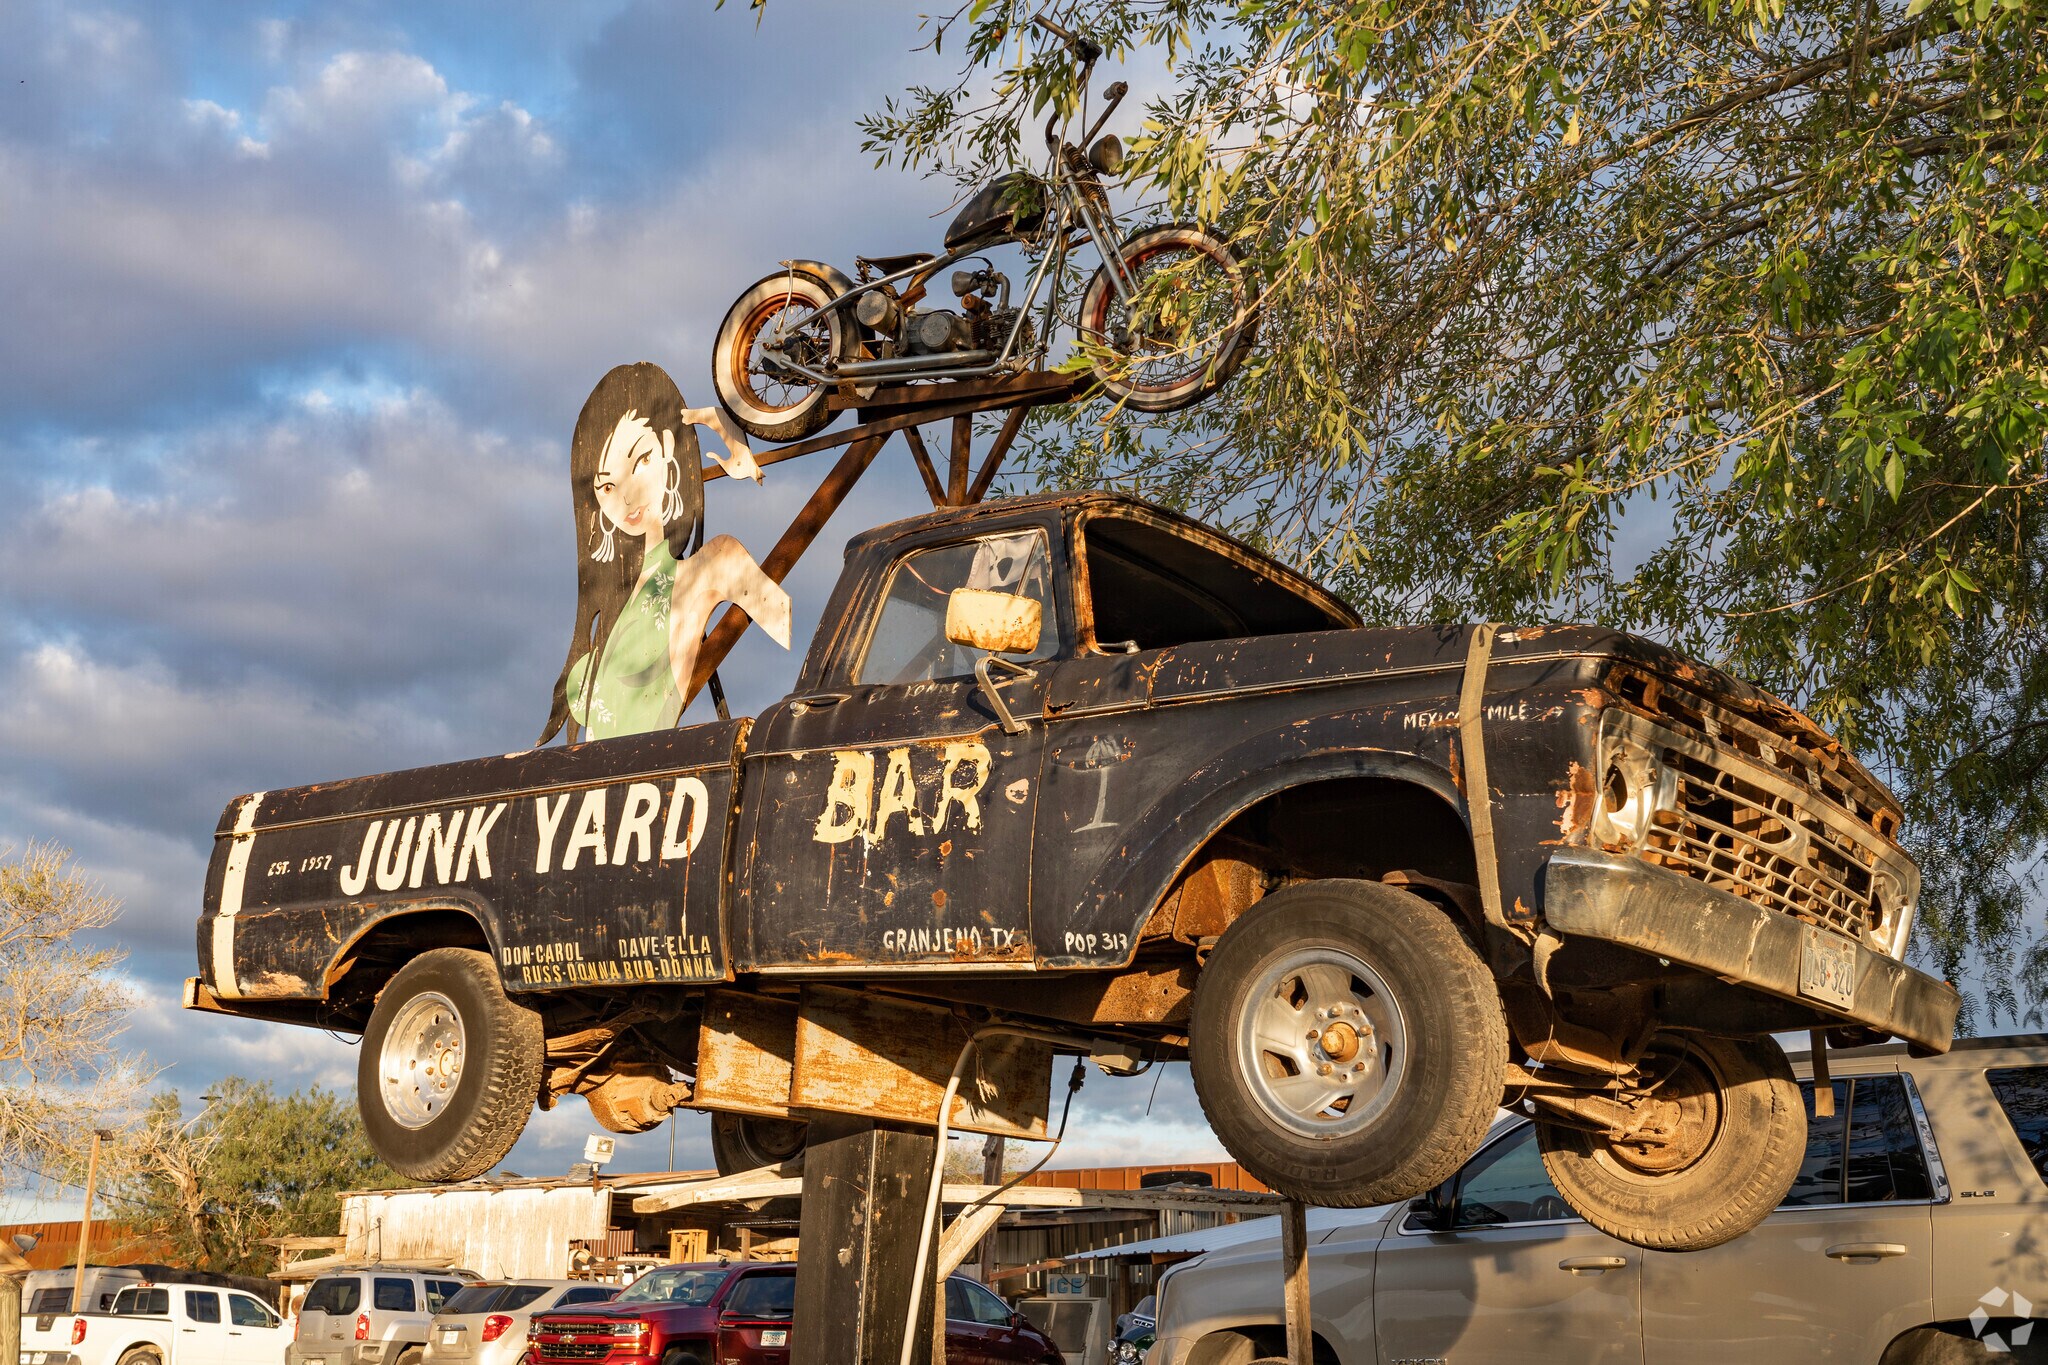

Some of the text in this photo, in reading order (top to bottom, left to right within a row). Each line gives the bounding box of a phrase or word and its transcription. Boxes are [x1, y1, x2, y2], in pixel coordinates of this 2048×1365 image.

[1487, 704, 1528, 721] MILE
[813, 743, 992, 846] BAR
[340, 777, 708, 896] JUNK YARD
[267, 854, 333, 877] EST. 1957
[991, 927, 1015, 952] TX
[1065, 932, 1097, 955] POP.
[1960, 1190, 1997, 1199] SLE
[1050, 1277, 1083, 1294] ICE
